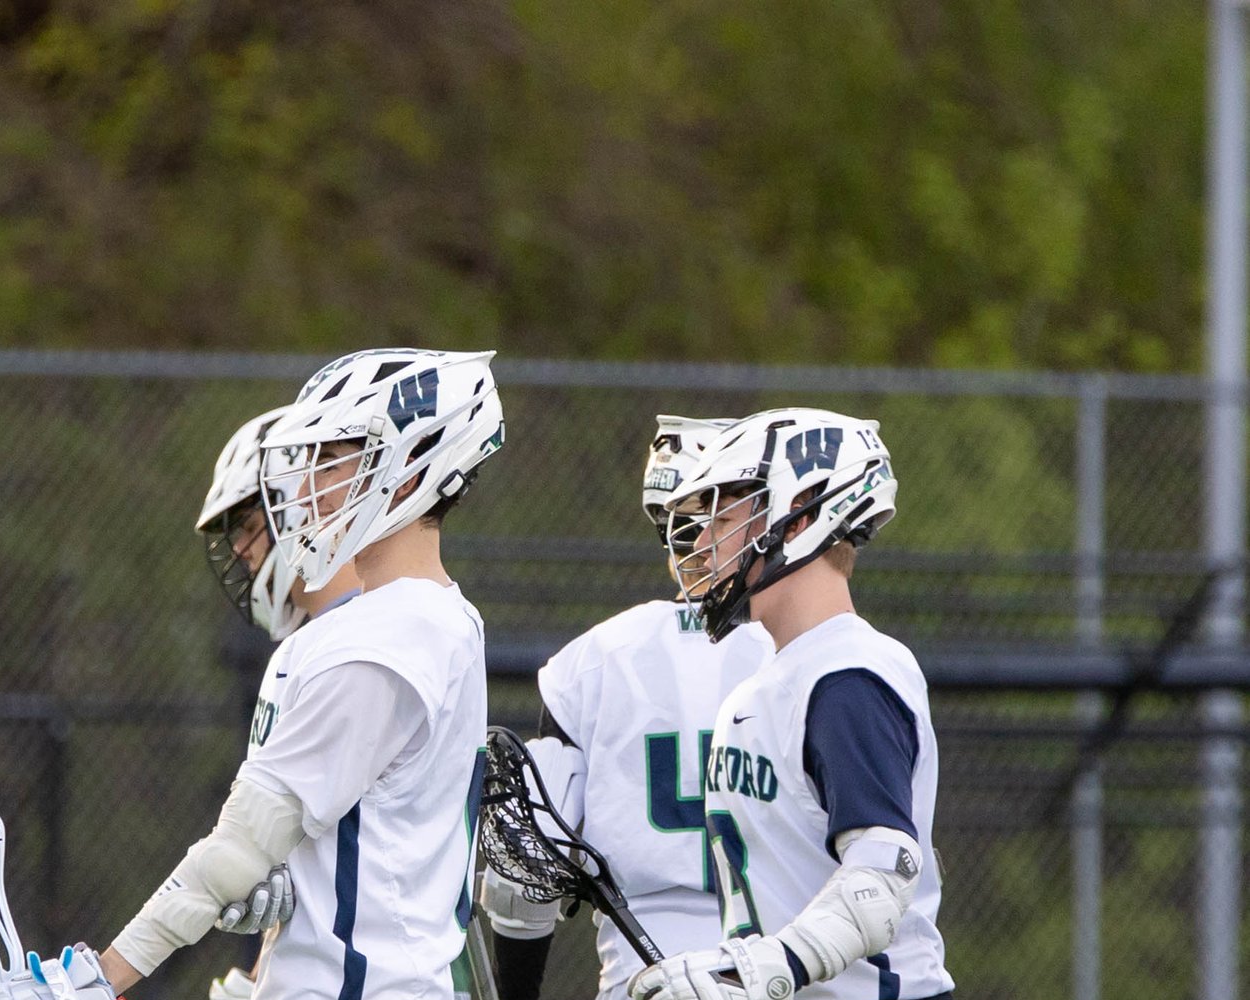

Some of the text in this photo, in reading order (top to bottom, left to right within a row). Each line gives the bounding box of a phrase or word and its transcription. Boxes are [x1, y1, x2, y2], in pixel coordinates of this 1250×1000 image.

[786, 427, 843, 481] W
[706, 745, 779, 803] FORD
[644, 729, 716, 894] 4
